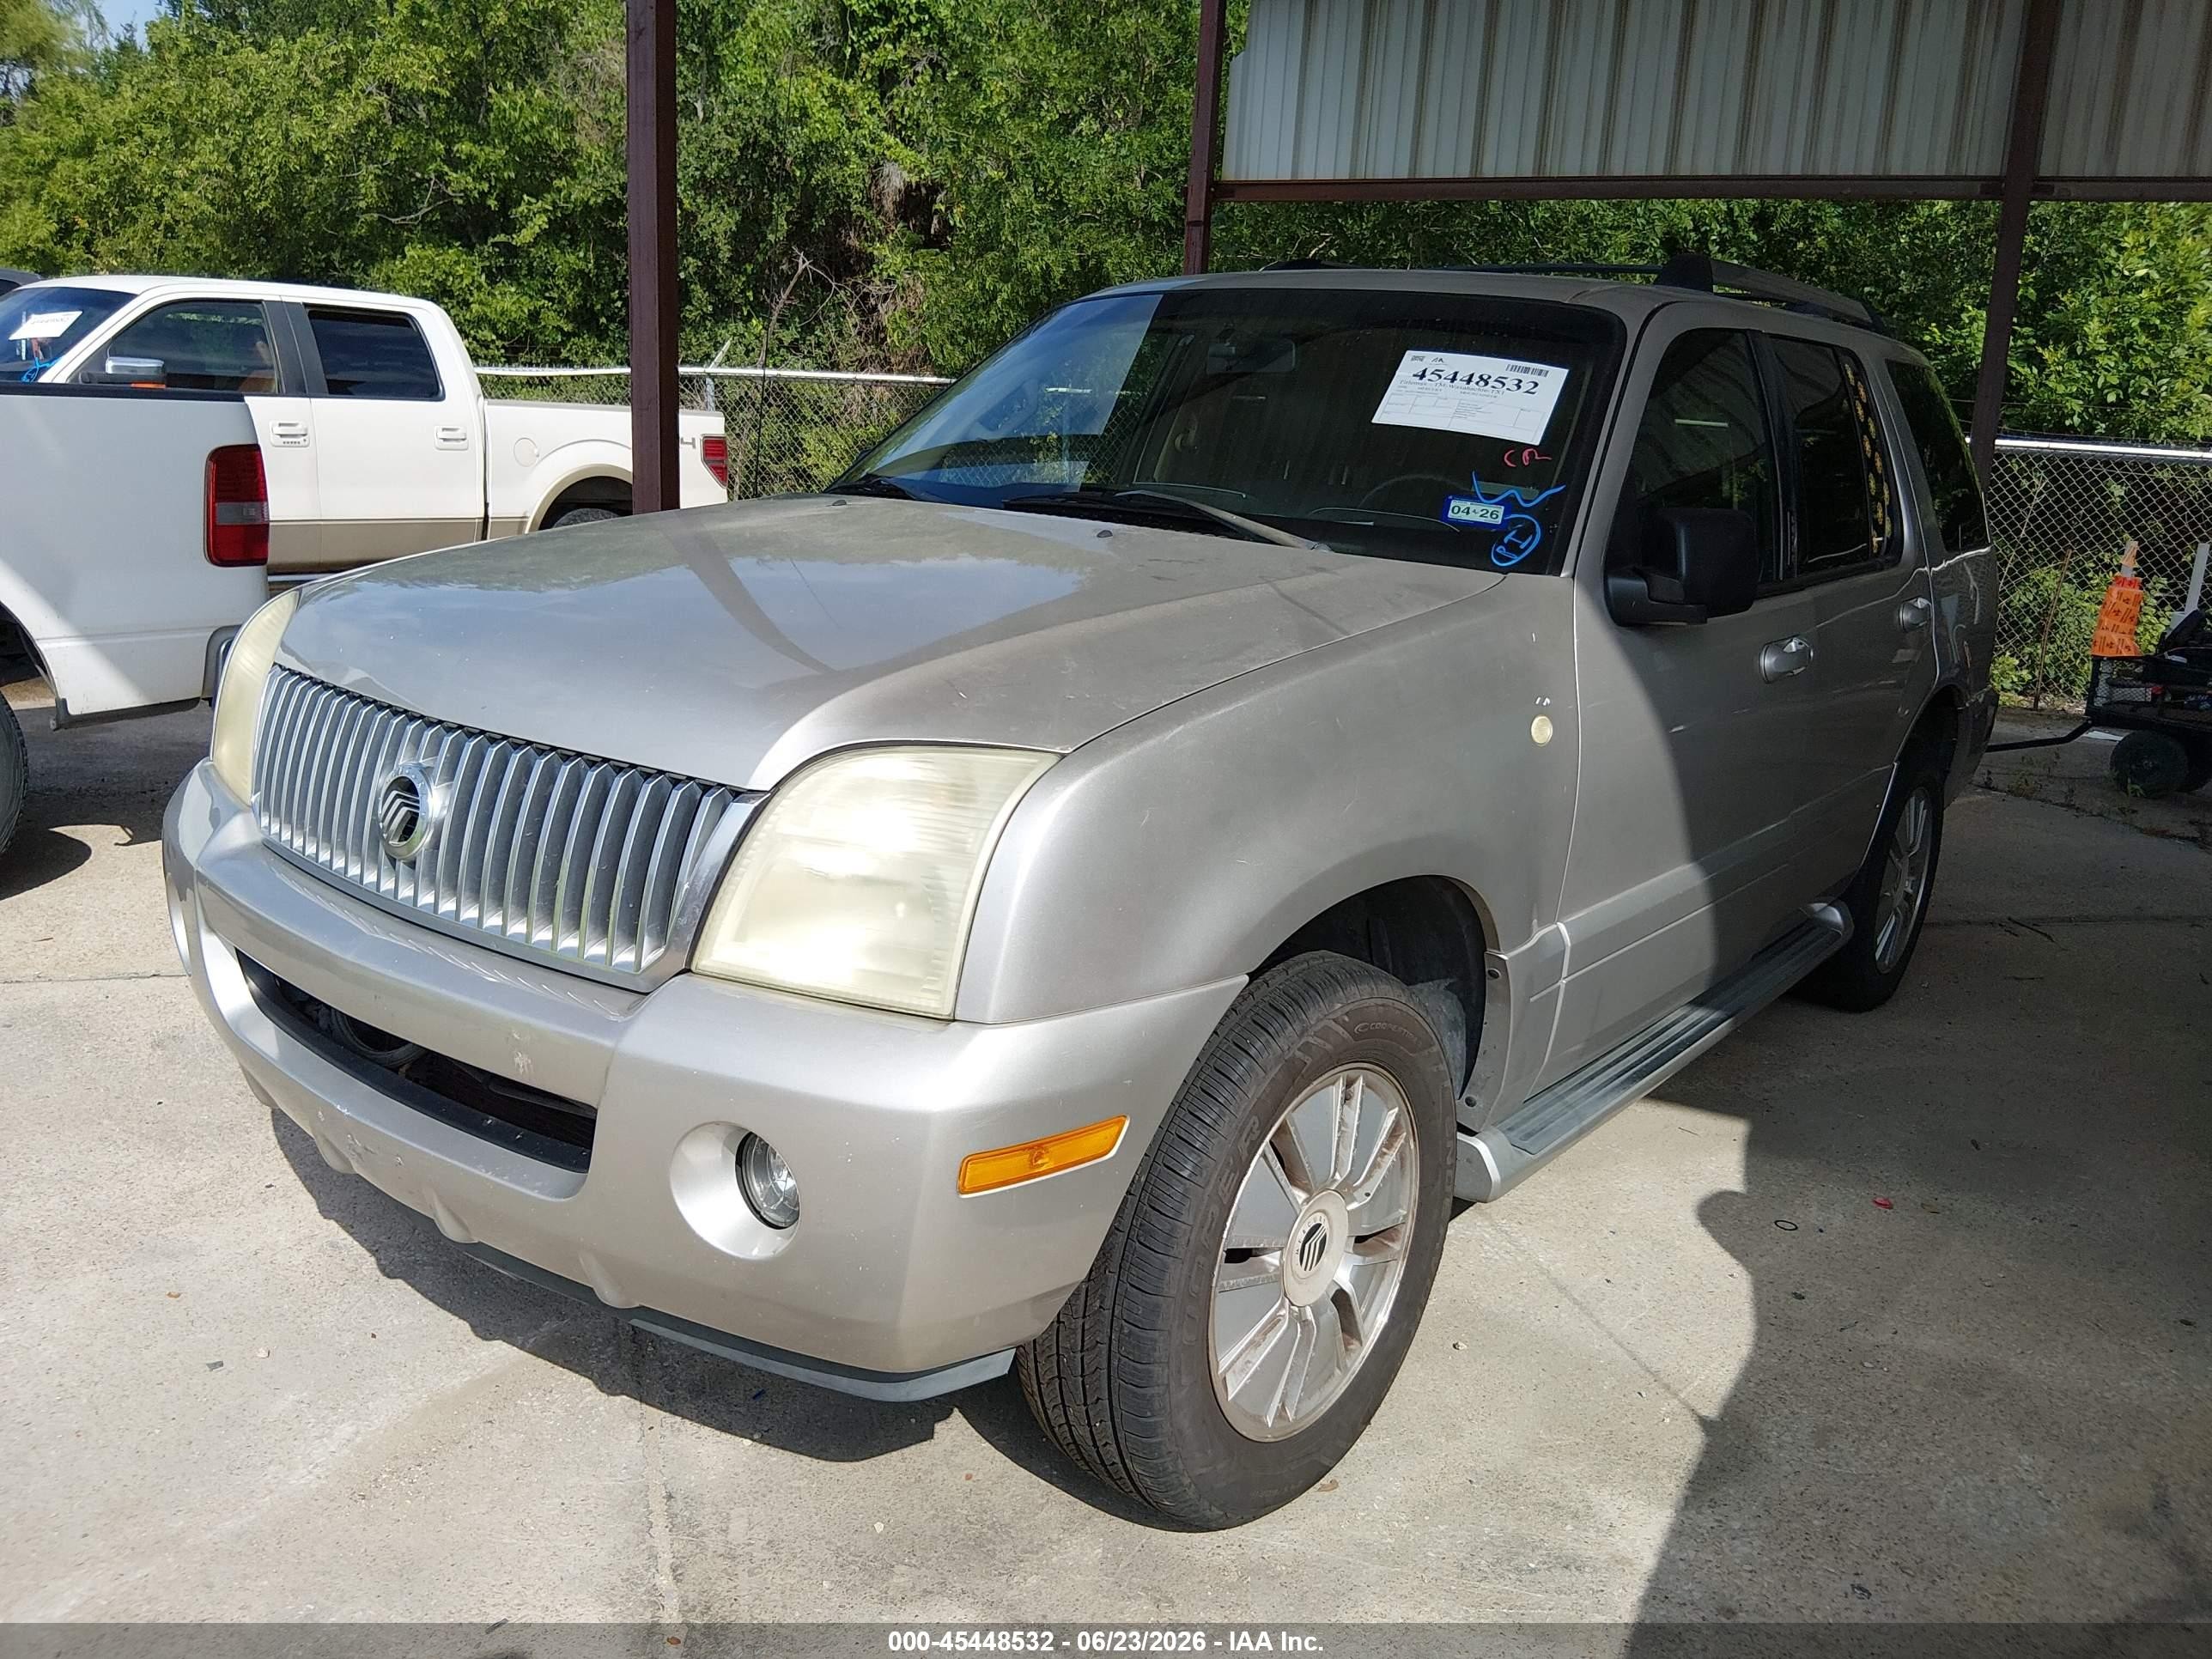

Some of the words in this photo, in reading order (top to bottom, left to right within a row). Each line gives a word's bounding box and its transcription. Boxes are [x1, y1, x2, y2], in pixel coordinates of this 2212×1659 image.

[1413, 367, 1540, 395] 45448532
[1450, 505, 1471, 516] 04
[1480, 508, 1500, 520] 26
